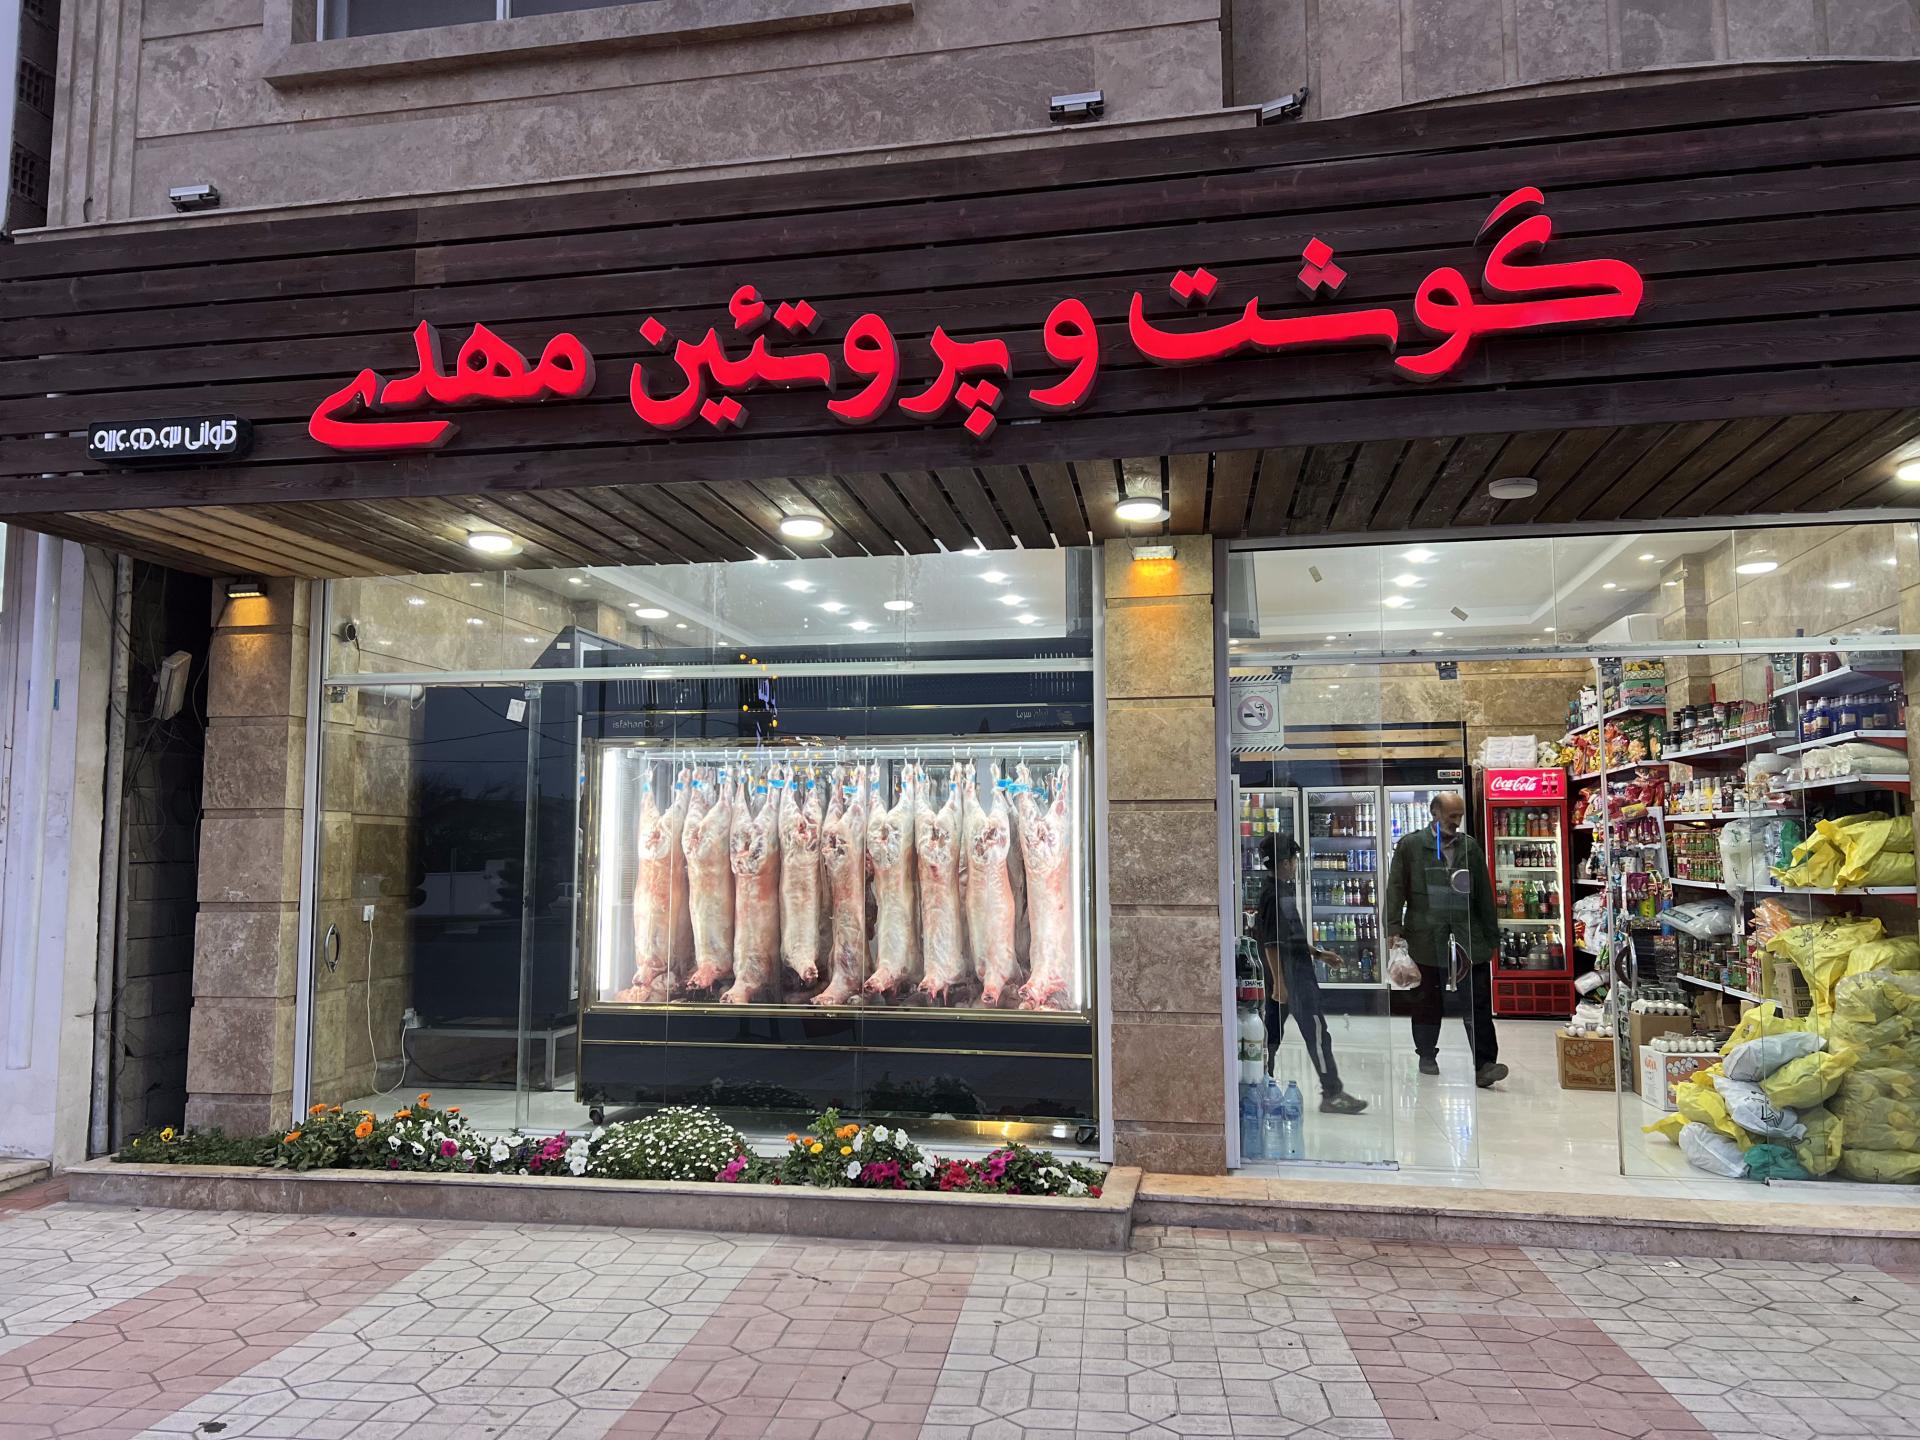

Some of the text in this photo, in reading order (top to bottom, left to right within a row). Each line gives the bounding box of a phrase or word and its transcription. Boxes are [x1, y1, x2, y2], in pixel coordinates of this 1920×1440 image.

[309, 186, 1644, 448] گوشت و پروتئین مهدی
[1490, 776, 1541, 792] Coca-Cola
